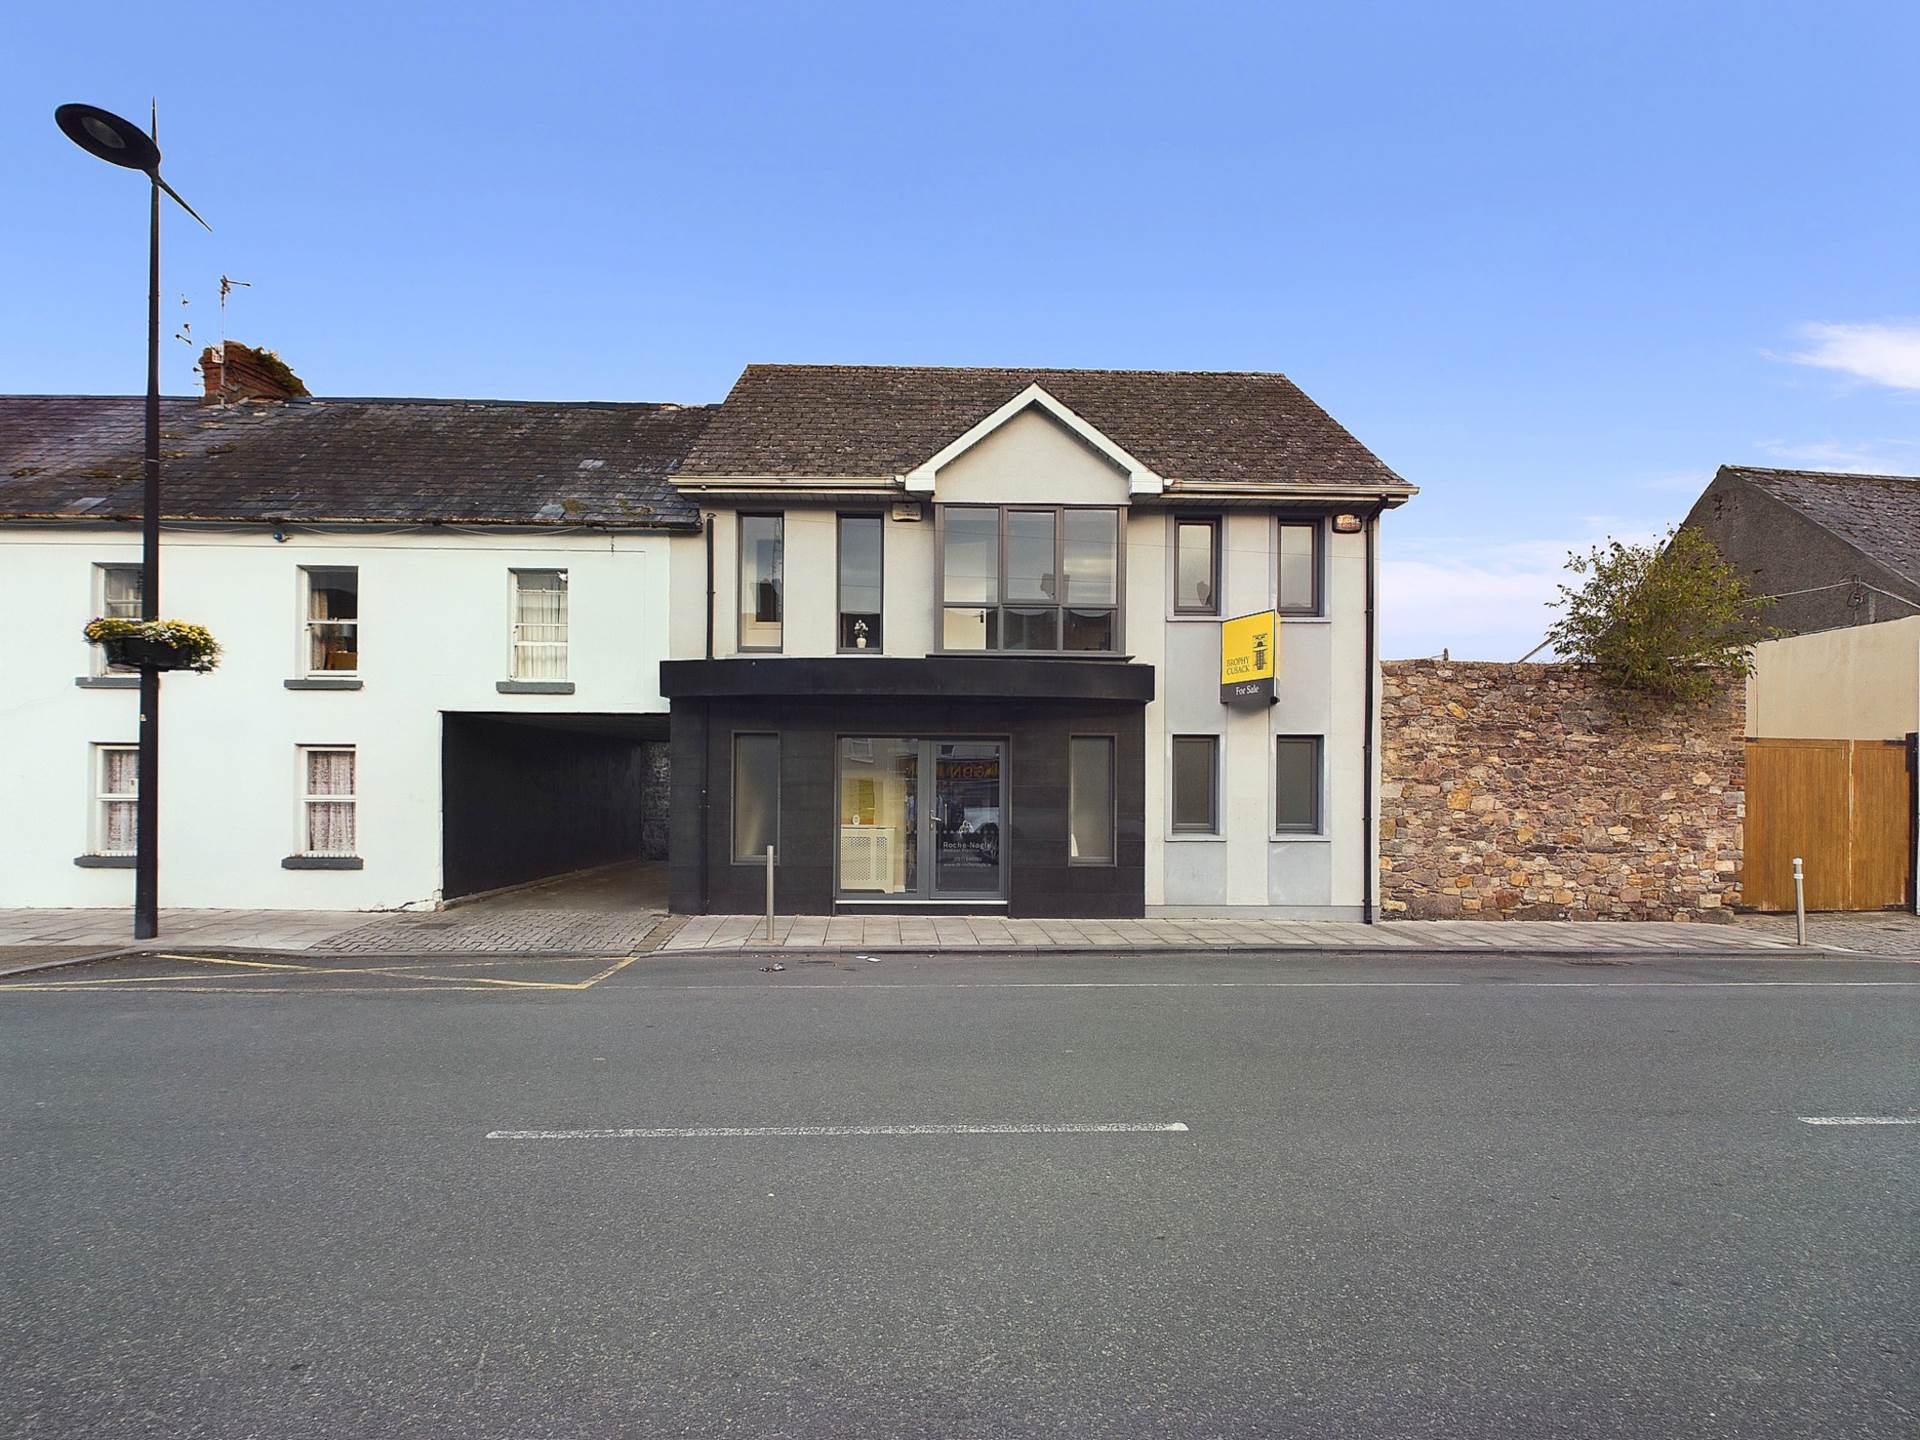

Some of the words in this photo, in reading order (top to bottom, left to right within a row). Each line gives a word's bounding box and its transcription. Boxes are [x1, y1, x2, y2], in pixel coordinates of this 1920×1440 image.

[1226, 656, 1249, 667] BROPHY
[1226, 665, 1250, 675] CUSACK
[1235, 686, 1245, 695] For
[1246, 684, 1259, 694] Sale
